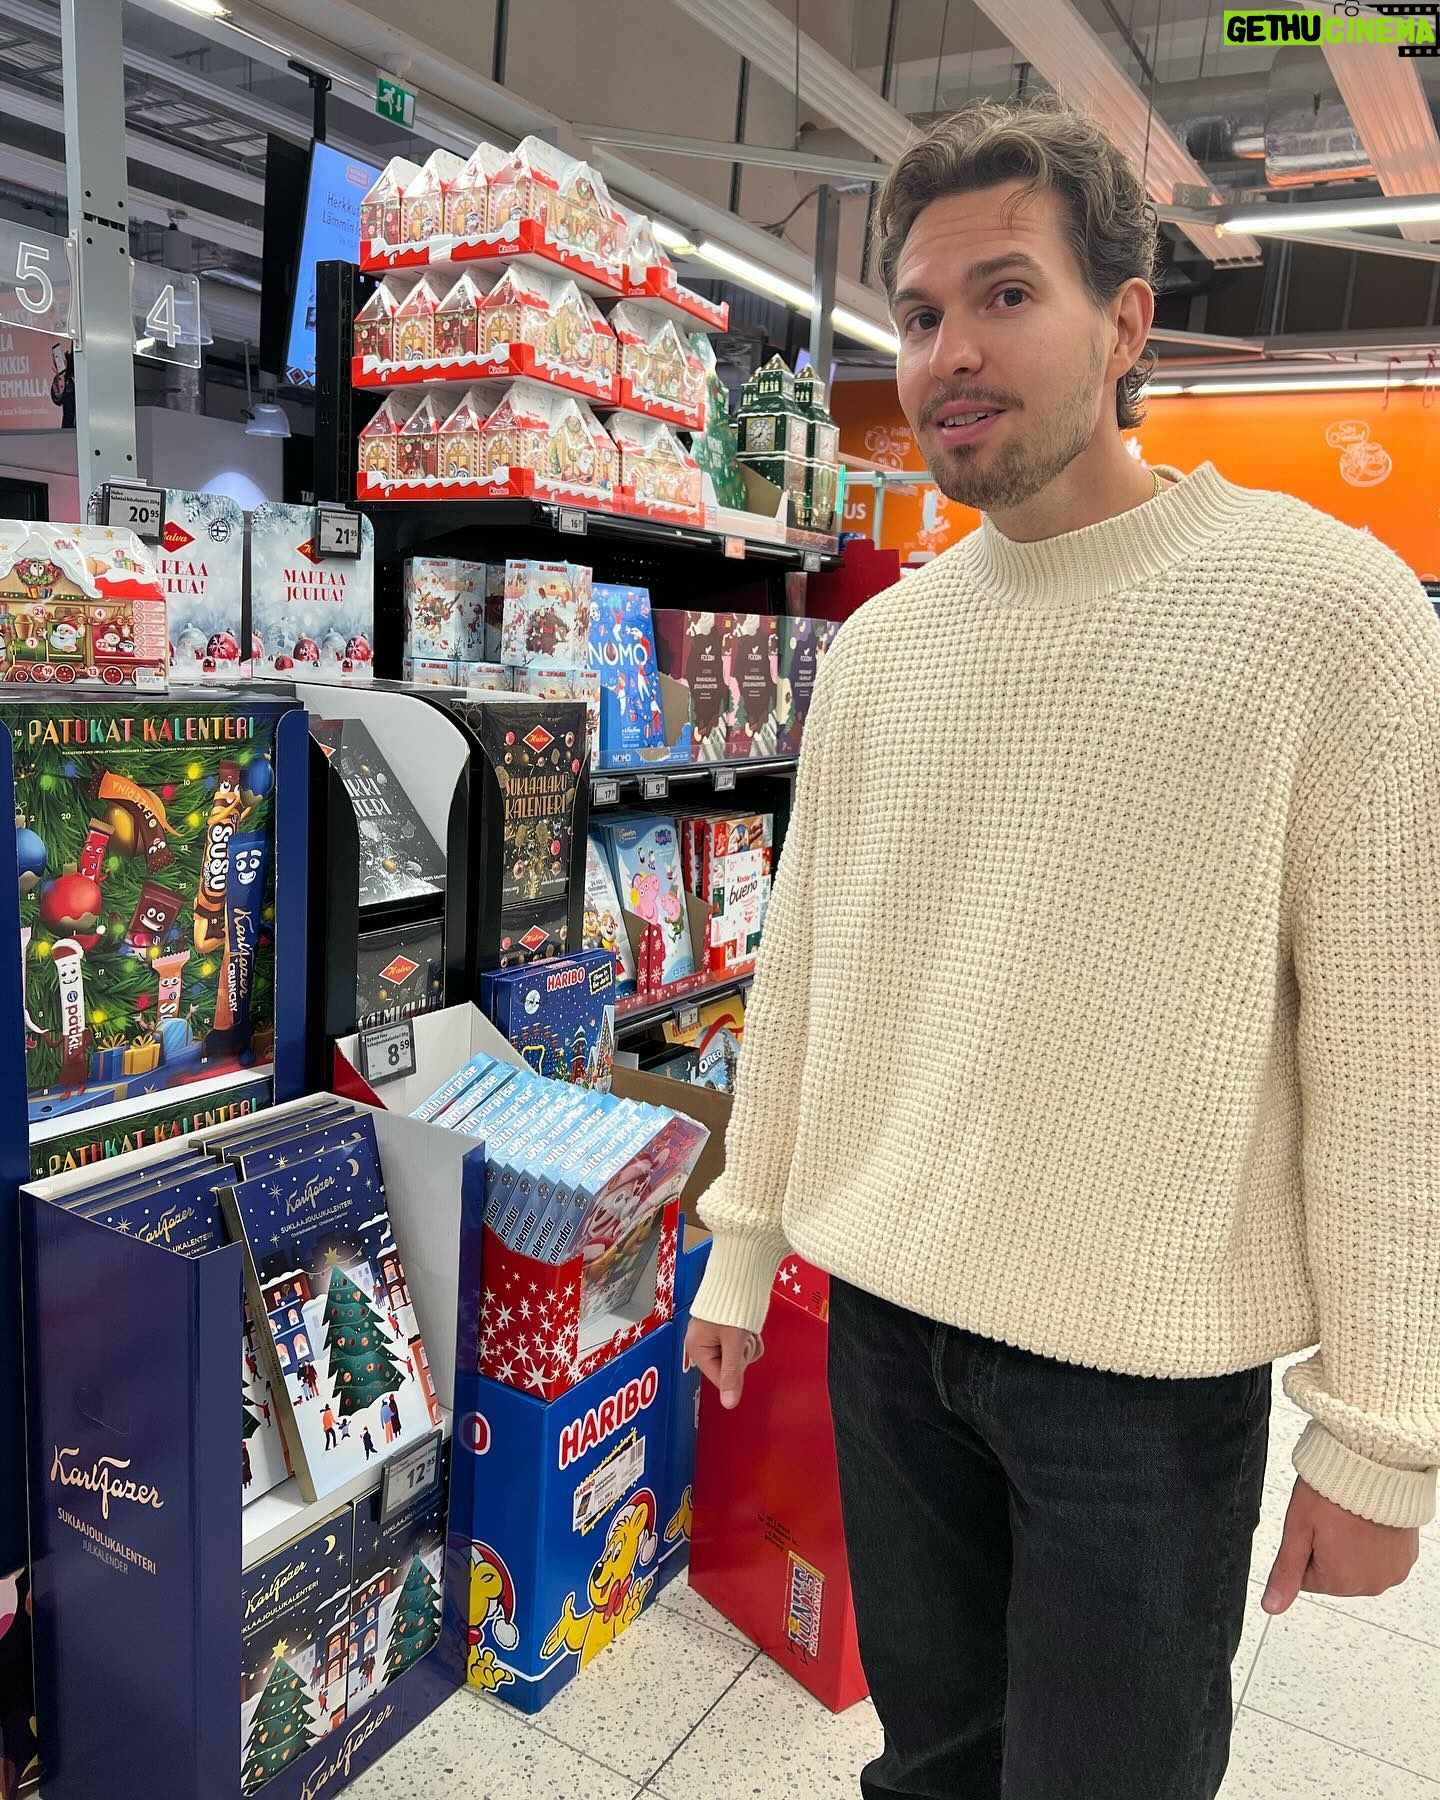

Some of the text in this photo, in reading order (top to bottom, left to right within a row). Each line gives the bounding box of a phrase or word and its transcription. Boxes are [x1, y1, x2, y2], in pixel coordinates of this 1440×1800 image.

[15, 241, 53, 314] 5
[146, 284, 182, 348] 4
[283, 568, 346, 586] MAKEAA
[286, 586, 343, 602] JOULUA!
[34, 608, 45, 616] 24
[97, 610, 103, 618] 4
[588, 642, 648, 667] NOMO
[88, 668, 97, 676] 13
[13, 729, 23, 737] 16
[28, 716, 254, 745] PATUKAT KALENTERI
[505, 773, 568, 796] SUKLAALAKU
[505, 795, 566, 821] KALENTERI
[729, 880, 758, 906] bueno
[388, 965, 412, 977] Halva
[547, 967, 585, 992] HARIBO
[227, 962, 238, 1012] CRUNCHY
[699, 1049, 723, 1073] OREO
[417, 1064, 478, 1120] with surprise
[460, 1074, 498, 1111] surprise
[478, 1082, 518, 1118] surprise
[490, 1092, 553, 1149] with surprise
[495, 1089, 535, 1126] surprise
[524, 1103, 587, 1161] with surprise
[544, 1108, 605, 1166] with surprise
[579, 1152, 603, 1177] with
[280, 1199, 354, 1234] SUKLAAJOULUKALENTERI
[559, 1366, 659, 1470] HARIBO
[57, 1507, 157, 1575] SUKLAAJOULUKALENTERI
[82, 1539, 129, 1575] JULKALENDER
